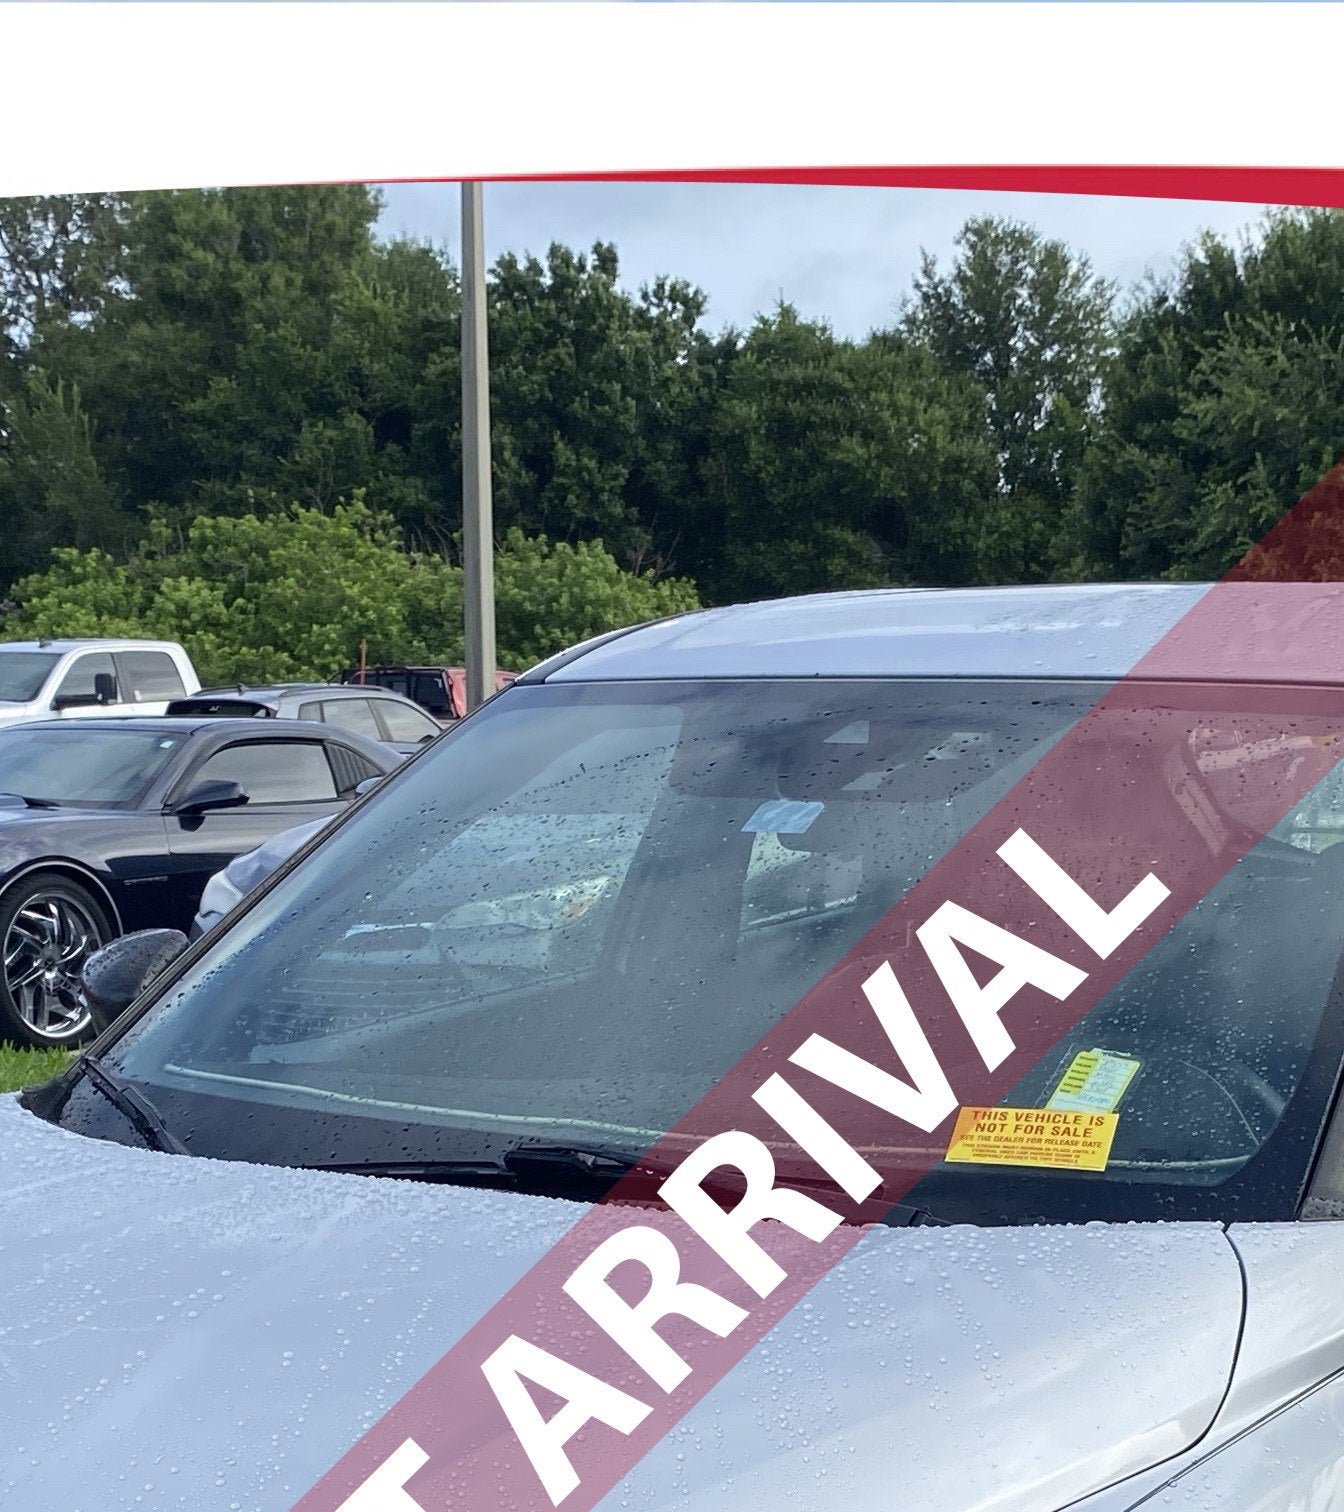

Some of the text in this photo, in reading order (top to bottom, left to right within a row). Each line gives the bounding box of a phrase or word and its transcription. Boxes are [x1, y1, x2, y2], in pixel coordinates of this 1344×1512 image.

[972, 1110, 1105, 1127] THIS VEHICLE IS
[975, 1122, 1093, 1138] NOT FOR SALE
[993, 1136, 1025, 1144] DEALER
[1026, 1137, 1043, 1145] FOR
[1044, 1138, 1080, 1147] RELEASE
[1081, 1140, 1103, 1149] DATE
